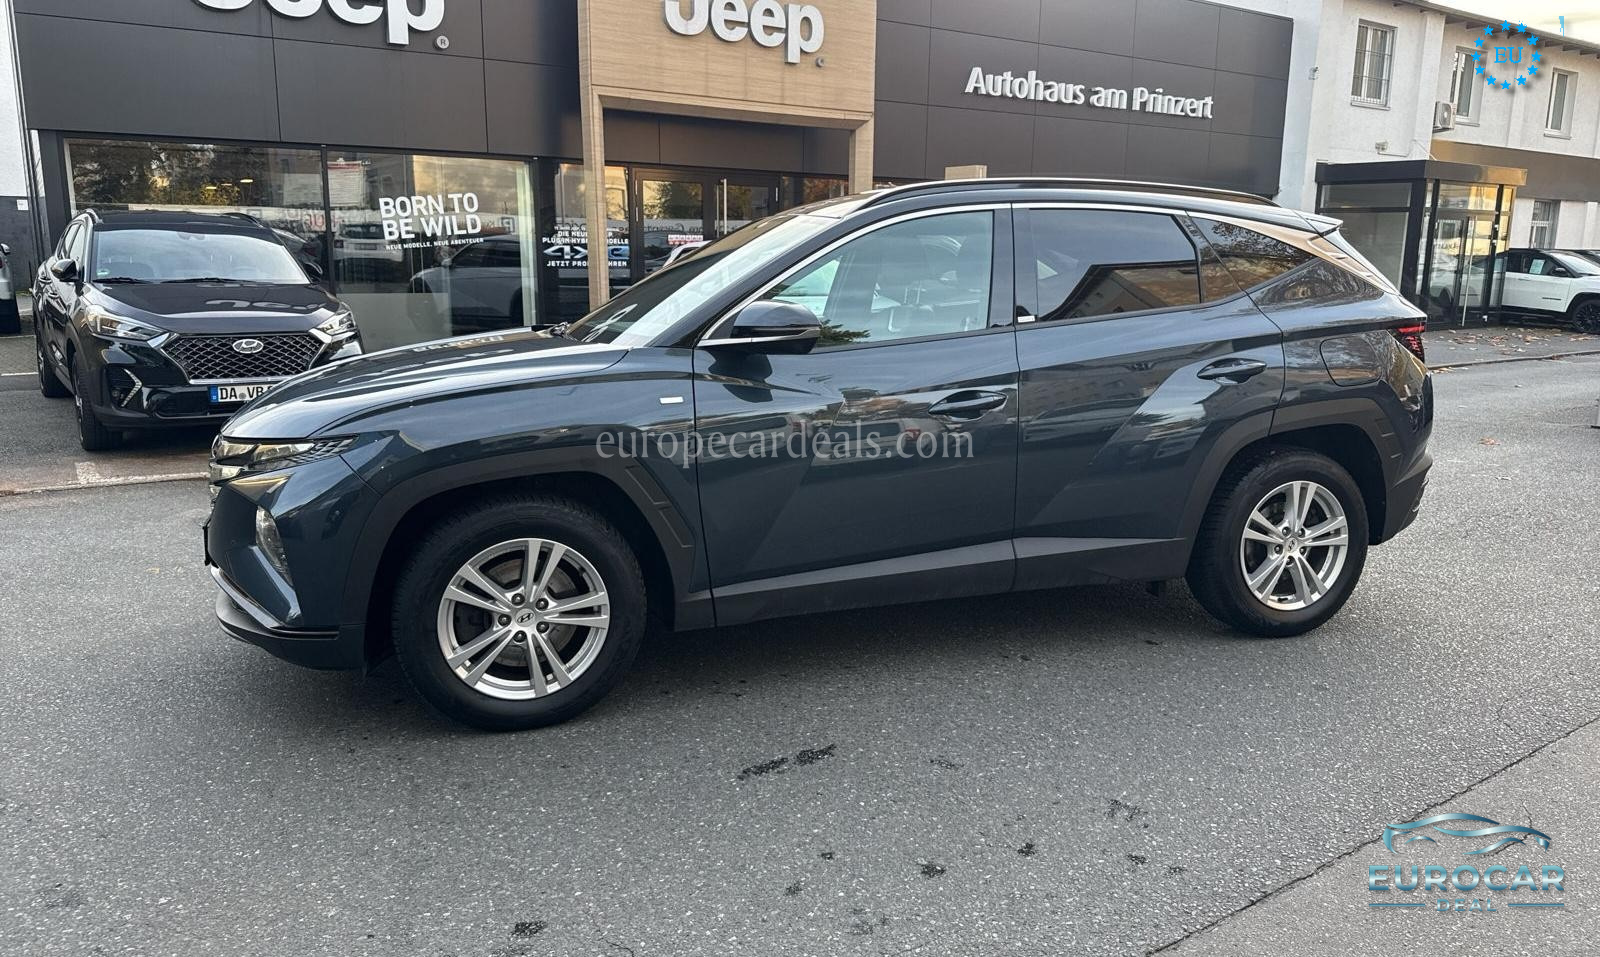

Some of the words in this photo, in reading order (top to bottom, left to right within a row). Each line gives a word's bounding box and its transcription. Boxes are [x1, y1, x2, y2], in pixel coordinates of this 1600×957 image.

[964, 66, 1085, 105] Autohaus
[1090, 86, 1127, 110] am
[1131, 86, 1214, 119] Prinzert
[379, 194, 445, 218] BORN
[447, 192, 479, 214] TO
[382, 218, 416, 241] BE
[420, 214, 482, 237] WILD
[450, 237, 484, 245] ABENTEUER
[220, 387, 238, 400] DA
